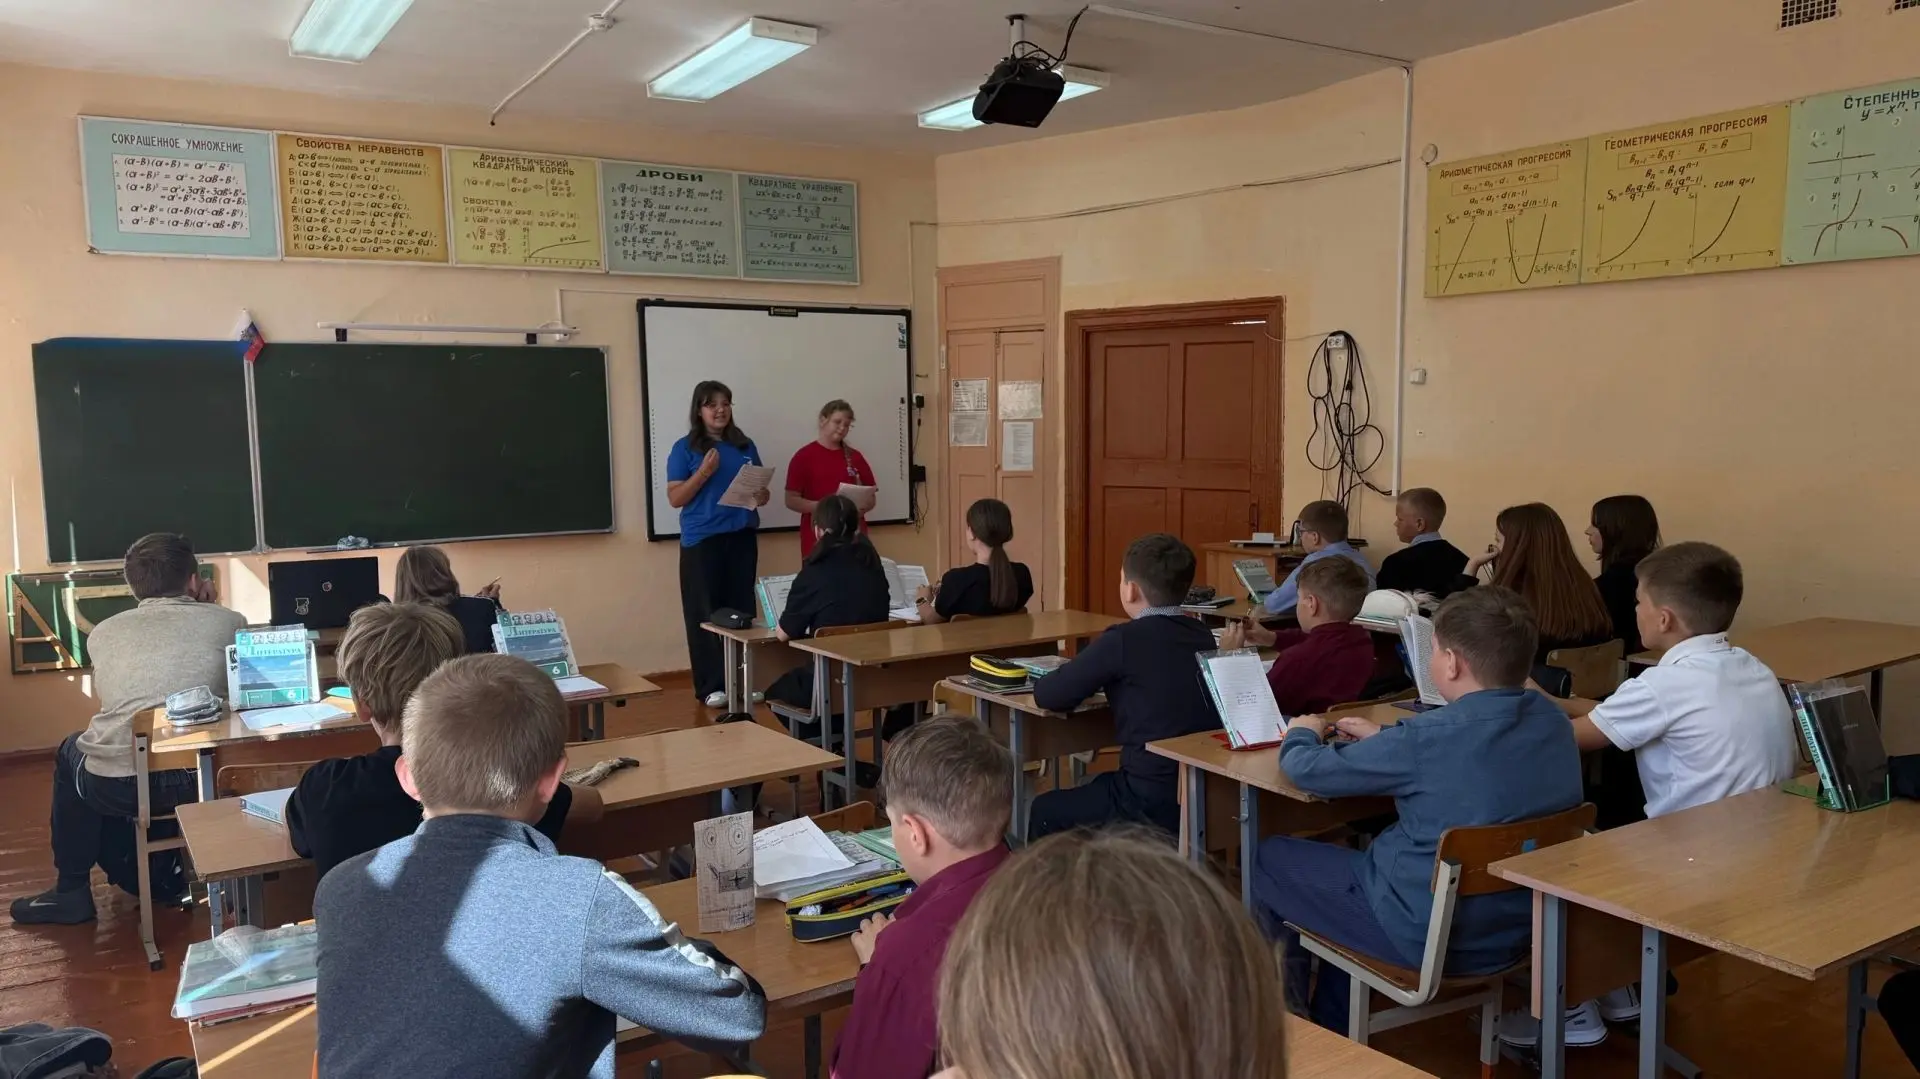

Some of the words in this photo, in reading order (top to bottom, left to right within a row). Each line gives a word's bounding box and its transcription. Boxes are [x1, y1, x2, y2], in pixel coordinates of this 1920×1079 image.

[1605, 128, 1693, 150] ГЕОМЕТРИЧЕСКАЯ
[1700, 115, 1767, 134] ПРОГРЕССИЯ
[186, 139, 244, 153] УМНОЖЕНИЕ
[296, 137, 351, 151] СВОЙСТВА
[358, 145, 424, 156] НЕРАВЕНСТВ
[480, 153, 569, 168] АРИФМЕТИЧЕСКИЙ
[1440, 160, 1513, 179] АРИФМЕТИЧЕСКАЯ
[1518, 150, 1571, 166] ПРОГРЕССИЯ
[473, 161, 535, 172] КВАДРАТНЫЙ
[540, 167, 575, 176] КОРЕНЬ
[636, 169, 703, 182] ДРОБИ
[507, 626, 557, 637] ЛИТЕРАТУРА
[552, 666, 561, 675] 6
